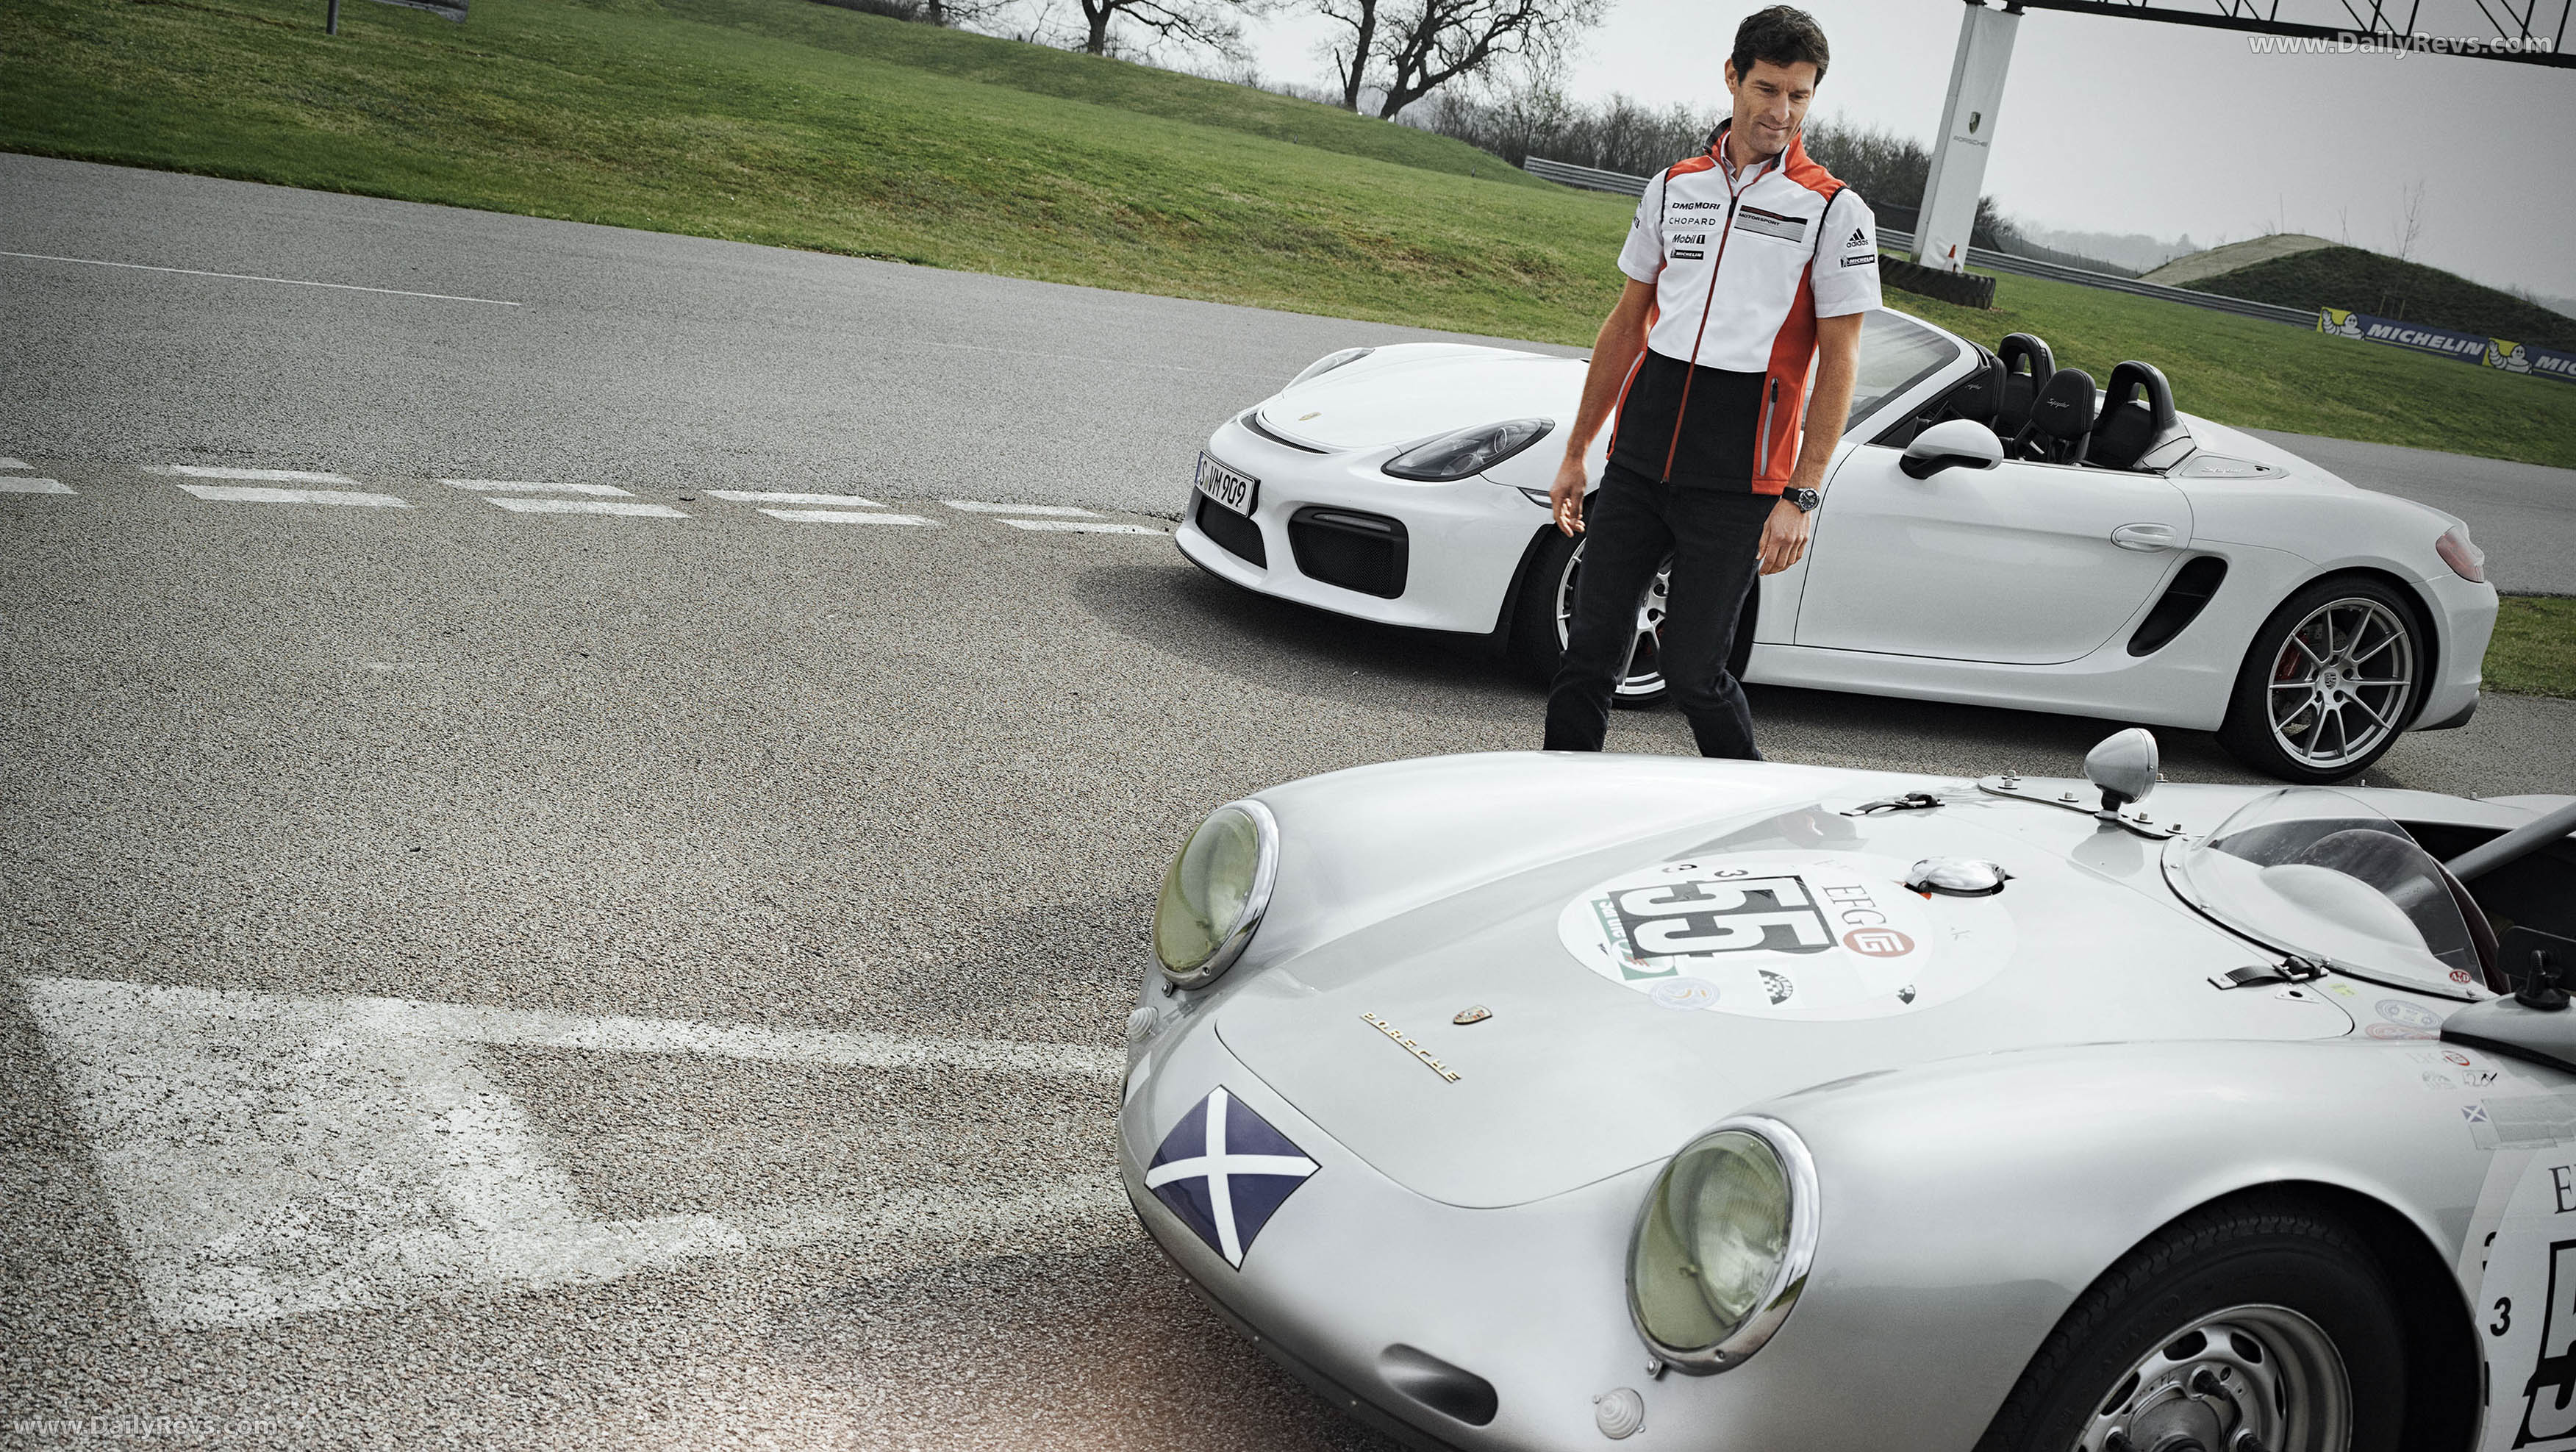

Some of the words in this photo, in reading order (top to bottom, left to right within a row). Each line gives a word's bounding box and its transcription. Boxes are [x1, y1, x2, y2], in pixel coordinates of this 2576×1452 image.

[1669, 217, 1717, 226] CHOPARD
[1738, 212, 1780, 226] MOTORSPORT
[1846, 239, 1869, 248] adidas
[2366, 323, 2485, 357] MICHELIN
[1714, 870, 1749, 878] 3
[1619, 876, 1831, 954] 55
[1822, 884, 1886, 926] EFG
[1359, 1012, 1461, 1084] PORSCHE
[2548, 1164, 2576, 1214] E
[2490, 1296, 2512, 1337] 3
